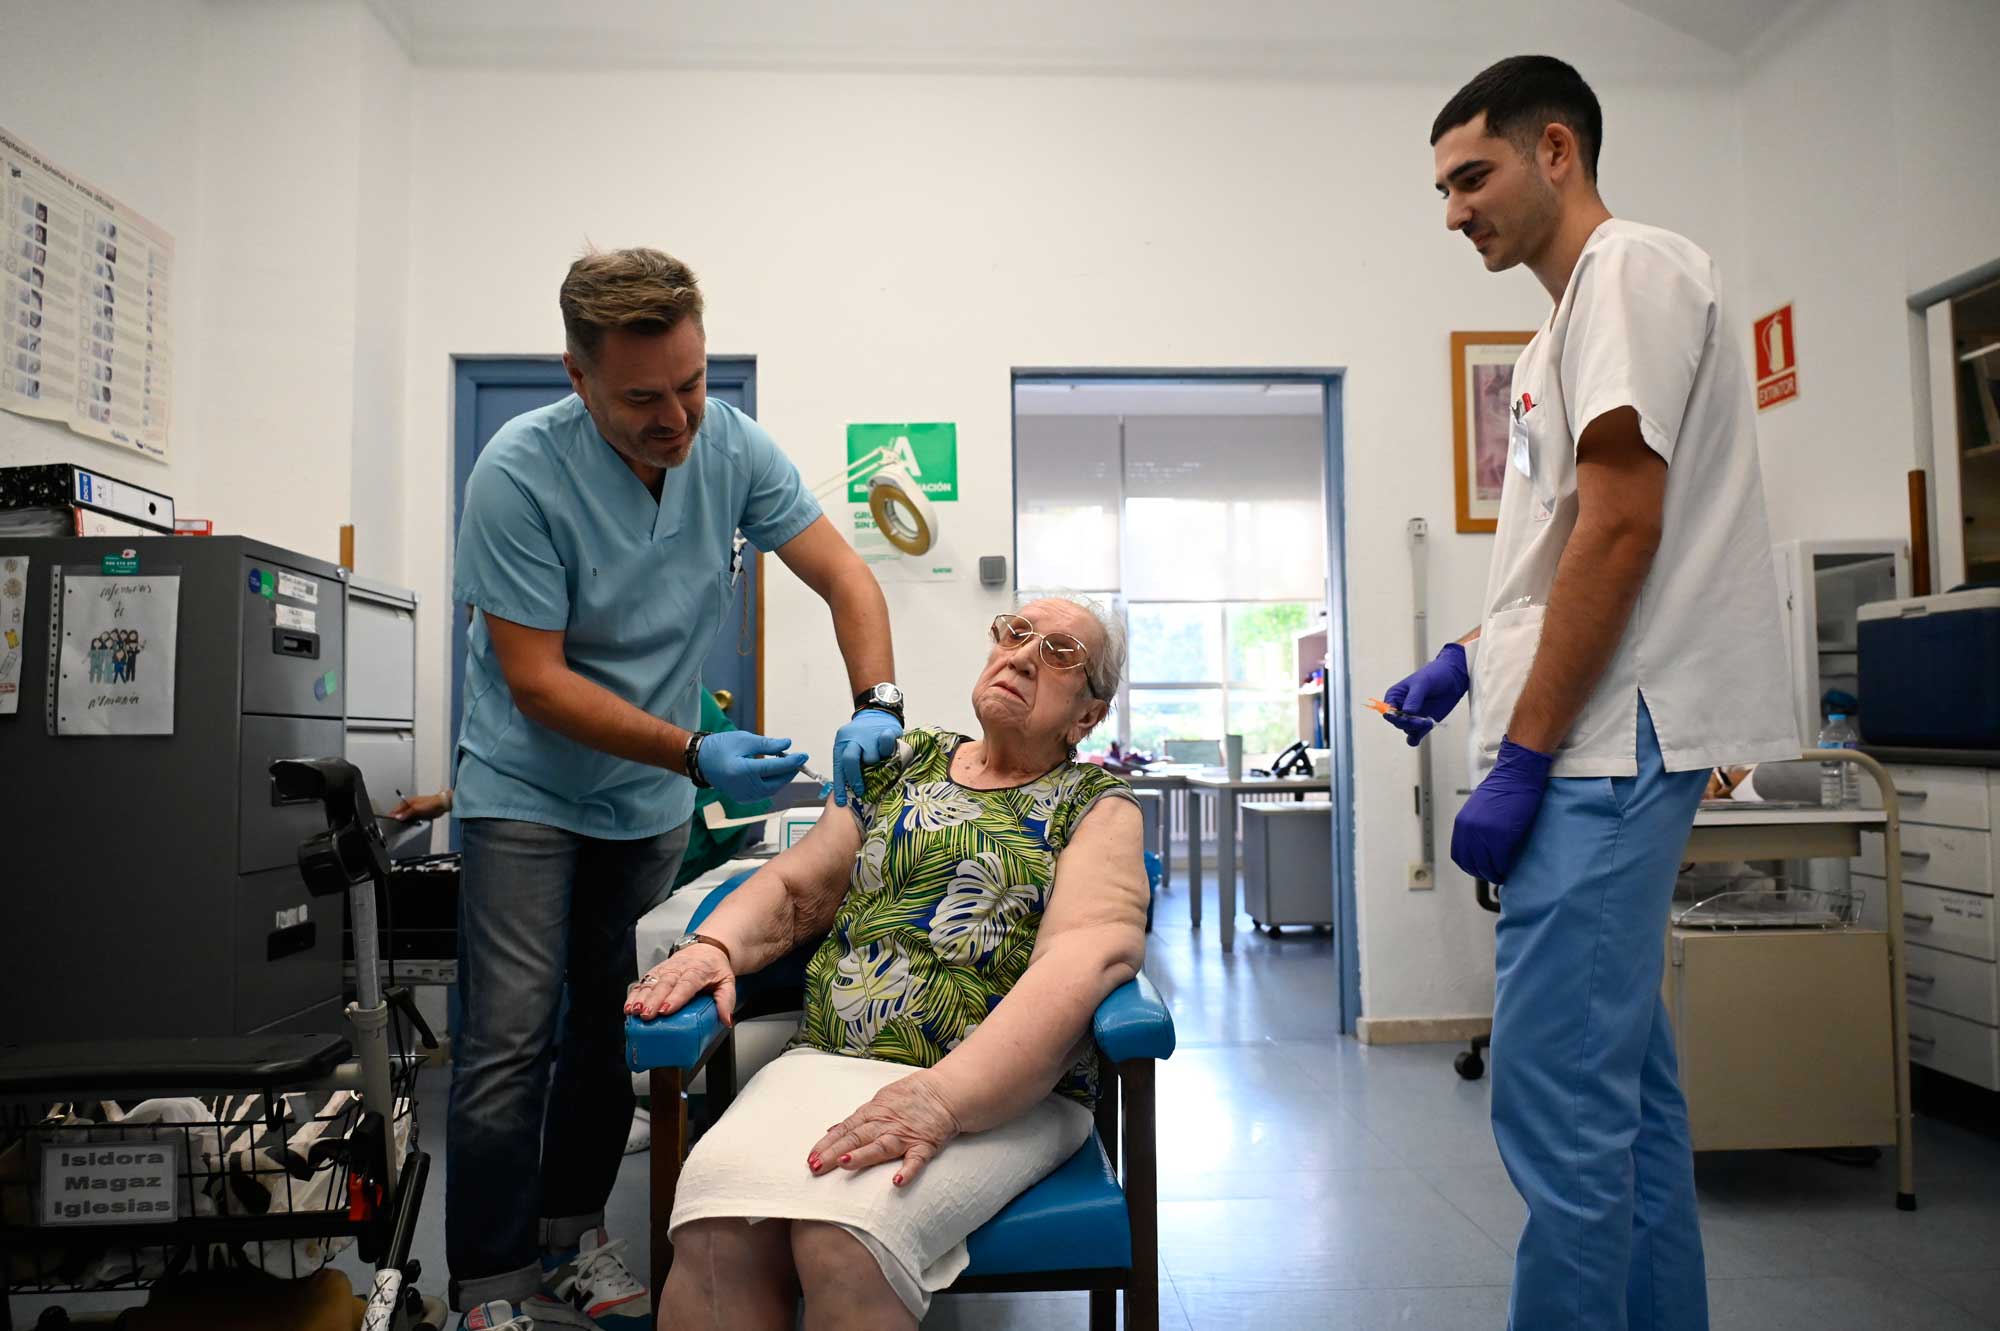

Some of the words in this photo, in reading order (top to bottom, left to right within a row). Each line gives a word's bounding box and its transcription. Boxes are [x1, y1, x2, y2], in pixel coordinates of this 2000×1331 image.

[893, 436, 922, 477] A
[61, 1151, 164, 1168] Isidora
[64, 1175, 162, 1193] Magaz
[53, 1198, 171, 1218] Iglesias
